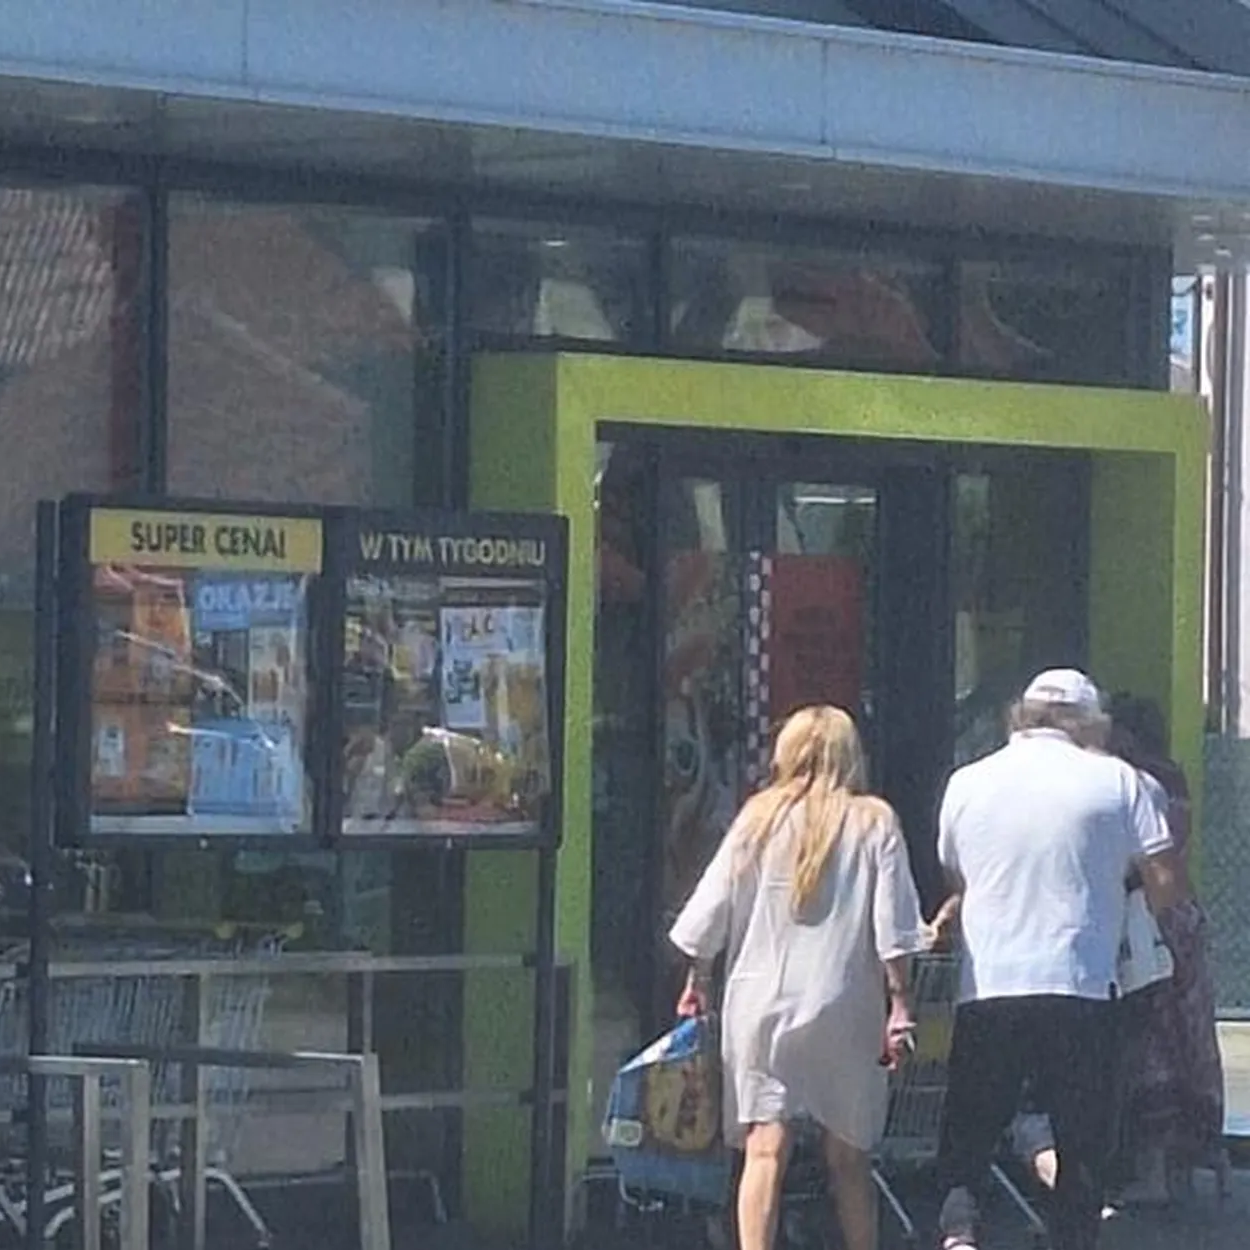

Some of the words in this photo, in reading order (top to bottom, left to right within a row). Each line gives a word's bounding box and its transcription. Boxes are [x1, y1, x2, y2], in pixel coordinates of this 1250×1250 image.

[130, 520, 206, 554] SUPER
[359, 531, 384, 561] W
[386, 533, 434, 564] TYM
[438, 536, 546, 567] TYGODNIU
